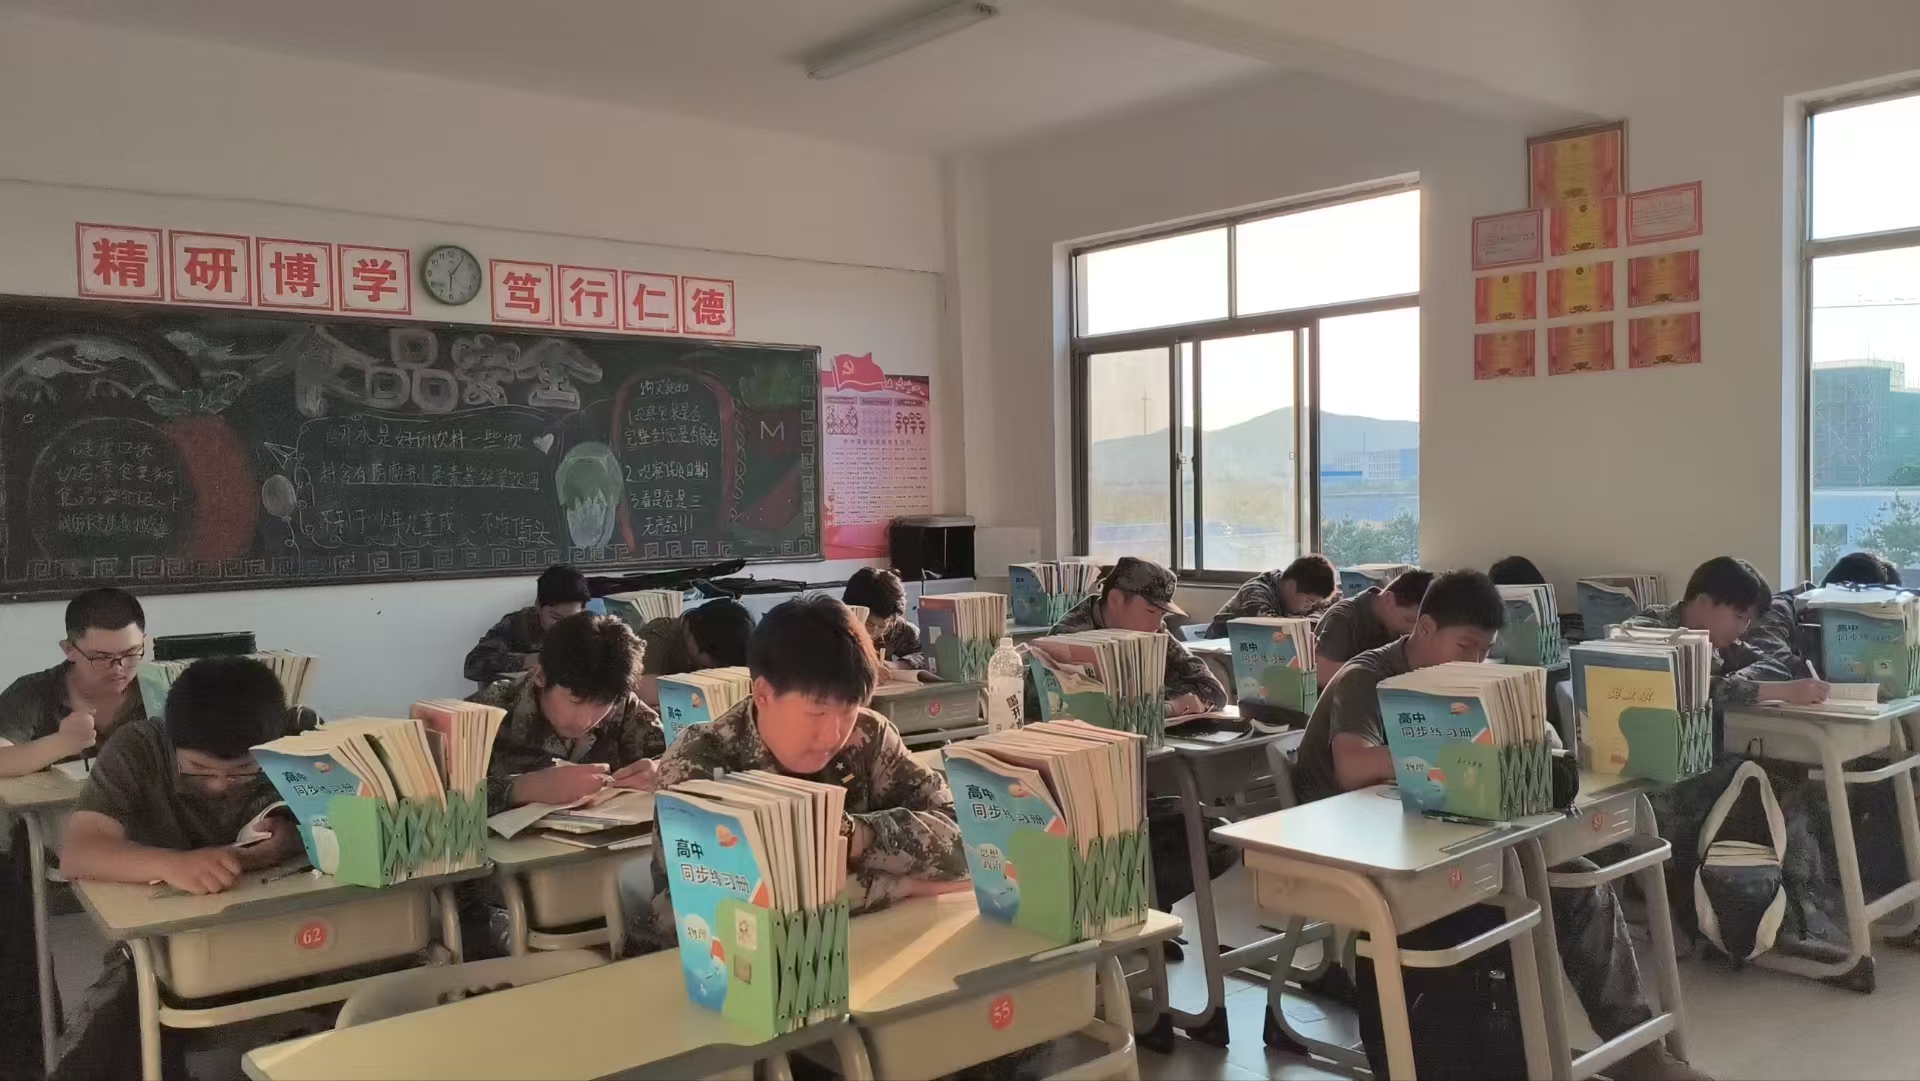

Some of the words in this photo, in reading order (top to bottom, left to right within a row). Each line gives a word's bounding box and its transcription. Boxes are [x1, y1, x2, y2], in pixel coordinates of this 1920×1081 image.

[92, 238, 398, 302] 精研博学
[502, 271, 727, 326] 笃行仁德
[1397, 712, 1426, 725] 高中
[1401, 726, 1473, 738] 同步练习册
[965, 784, 996, 801] 高中
[971, 803, 1047, 826] 同步练习册
[675, 838, 705, 860] 高中
[680, 862, 751, 895] 同步练习册
[302, 926, 322, 945] 62
